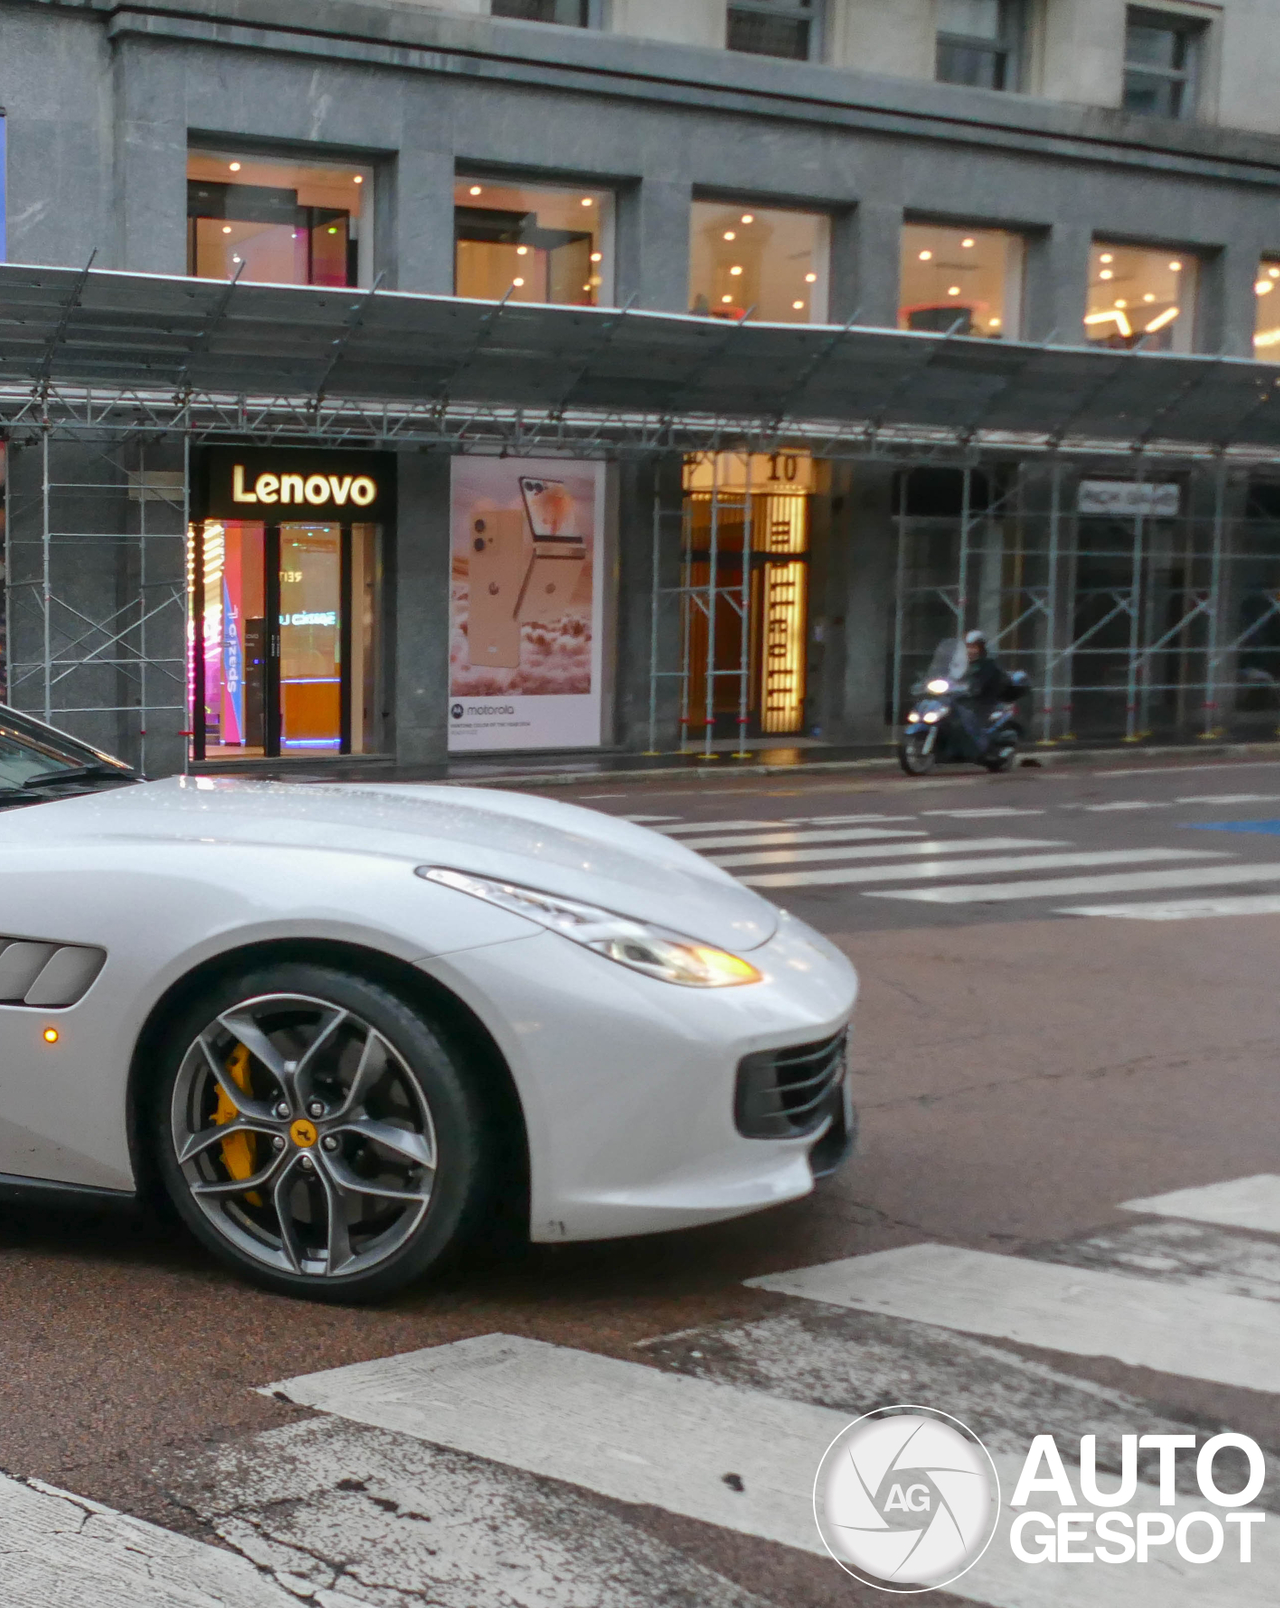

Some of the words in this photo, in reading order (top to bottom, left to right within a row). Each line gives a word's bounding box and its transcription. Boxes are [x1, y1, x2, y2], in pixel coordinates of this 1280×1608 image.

[767, 453, 797, 481] 10
[233, 465, 376, 506] Lenovo
[467, 705, 515, 716] motorola
